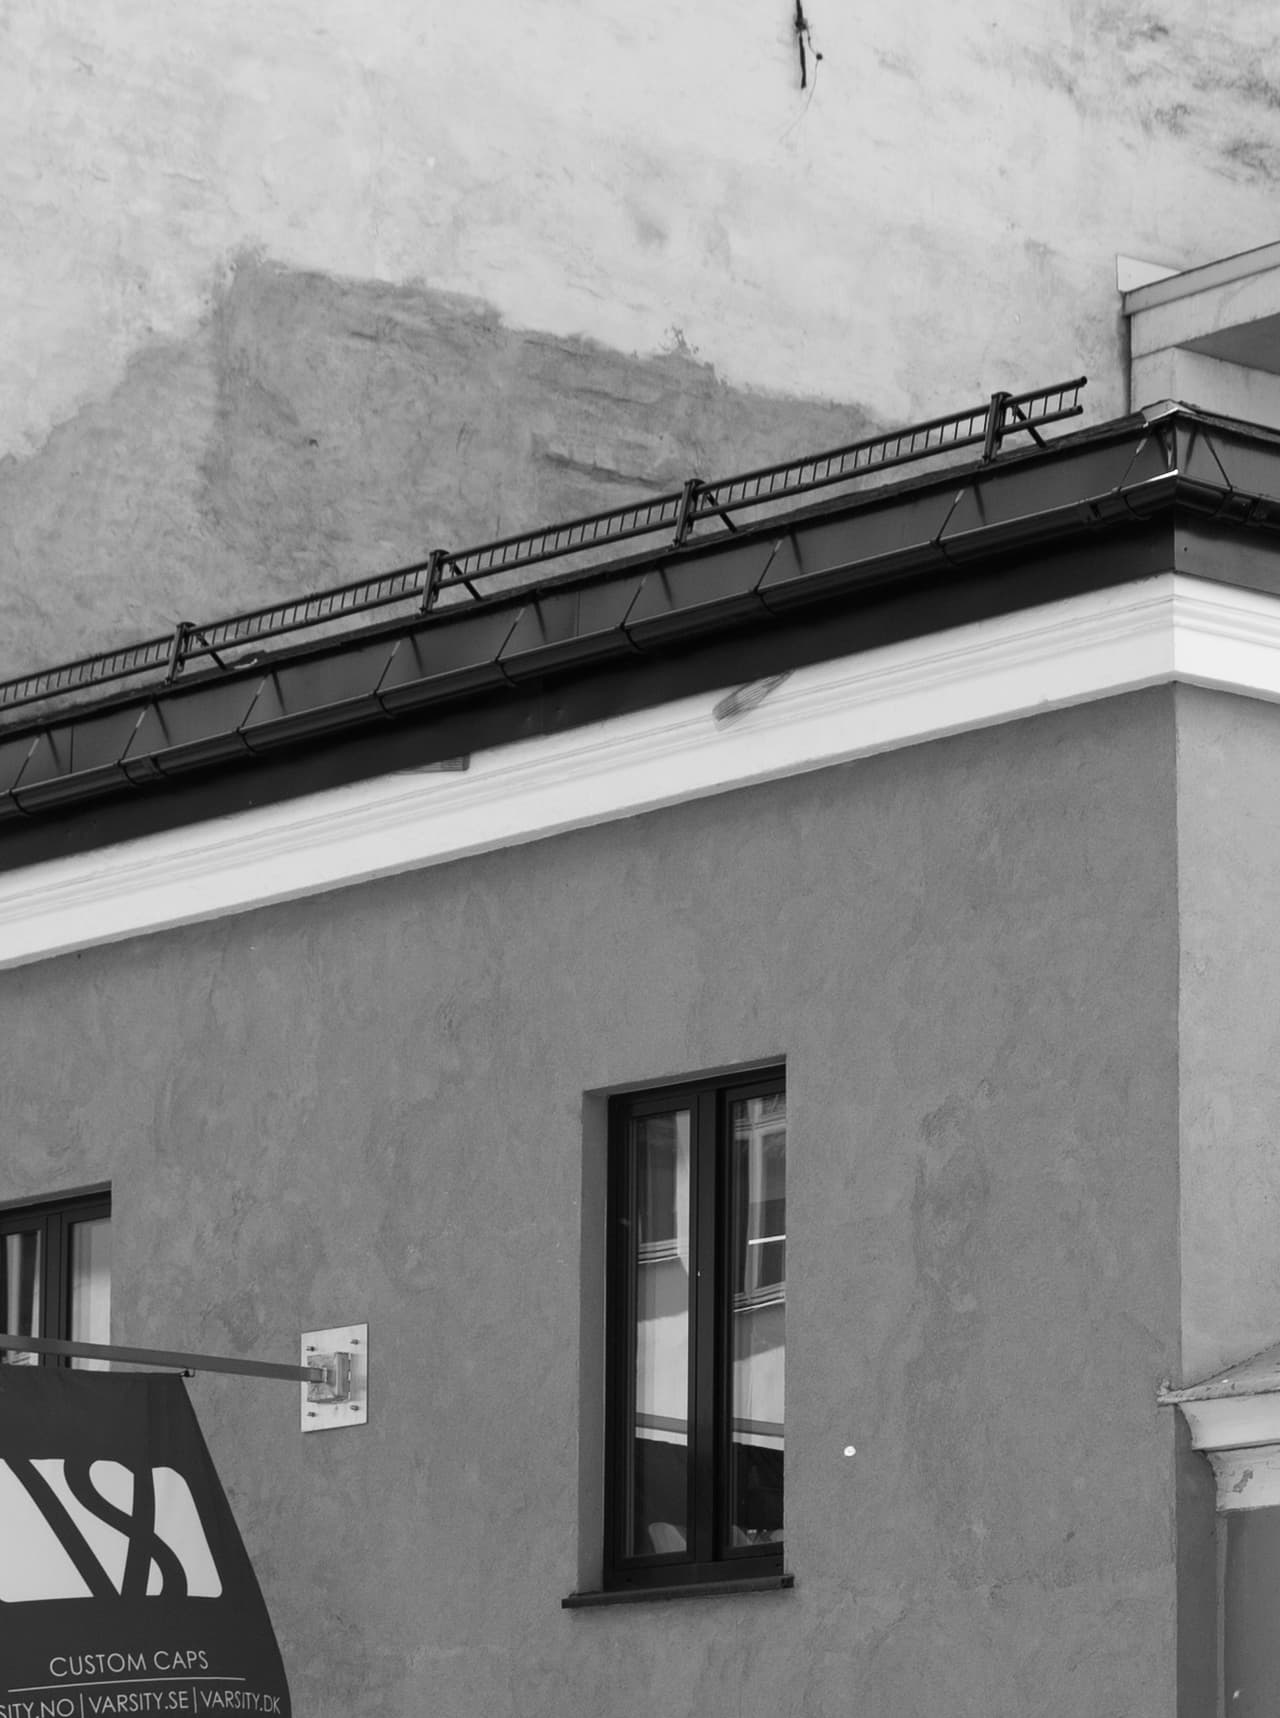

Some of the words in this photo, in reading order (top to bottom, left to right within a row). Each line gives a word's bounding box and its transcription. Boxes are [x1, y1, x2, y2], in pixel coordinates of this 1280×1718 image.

[49, 1652, 148, 1678] CUSTOM
[153, 1650, 209, 1671] CAPS
[88, 1691, 189, 1715] VARSITY.SE
[200, 1691, 282, 1715] VARSITY.DK
